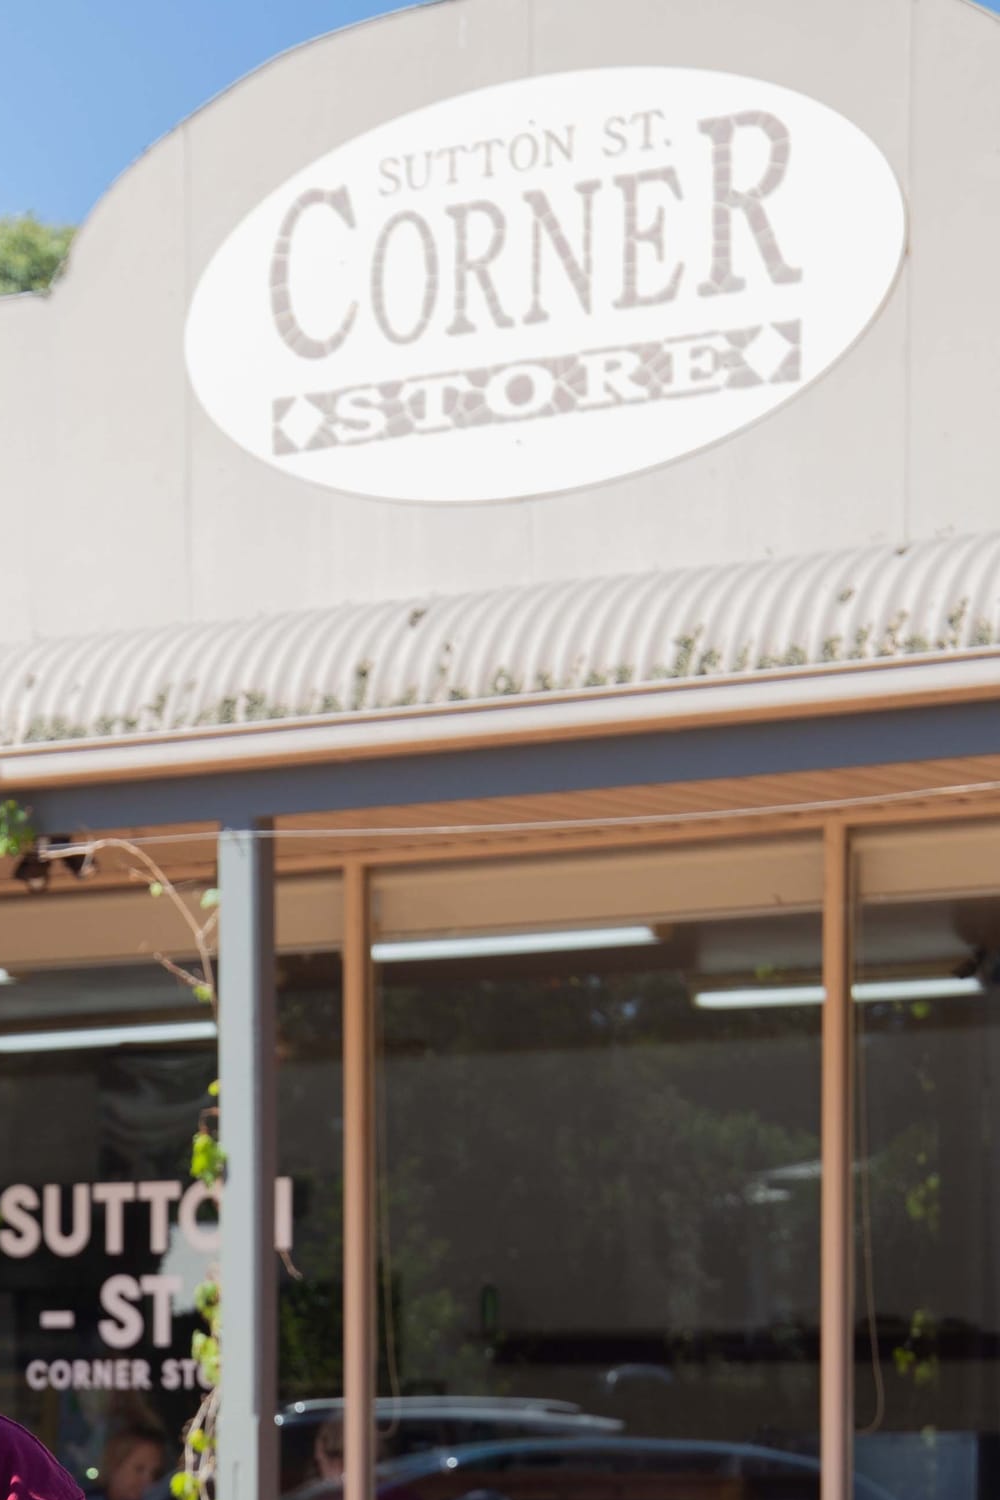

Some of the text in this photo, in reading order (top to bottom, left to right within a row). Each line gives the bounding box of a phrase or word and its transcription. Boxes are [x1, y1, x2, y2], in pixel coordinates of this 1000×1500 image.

[377, 109, 673, 198] SUTTON ST.
[269, 108, 803, 360] CORNER
[331, 333, 732, 444] STORE
[98, 1273, 183, 1348] ST
[26, 1358, 151, 1390] CORNER
